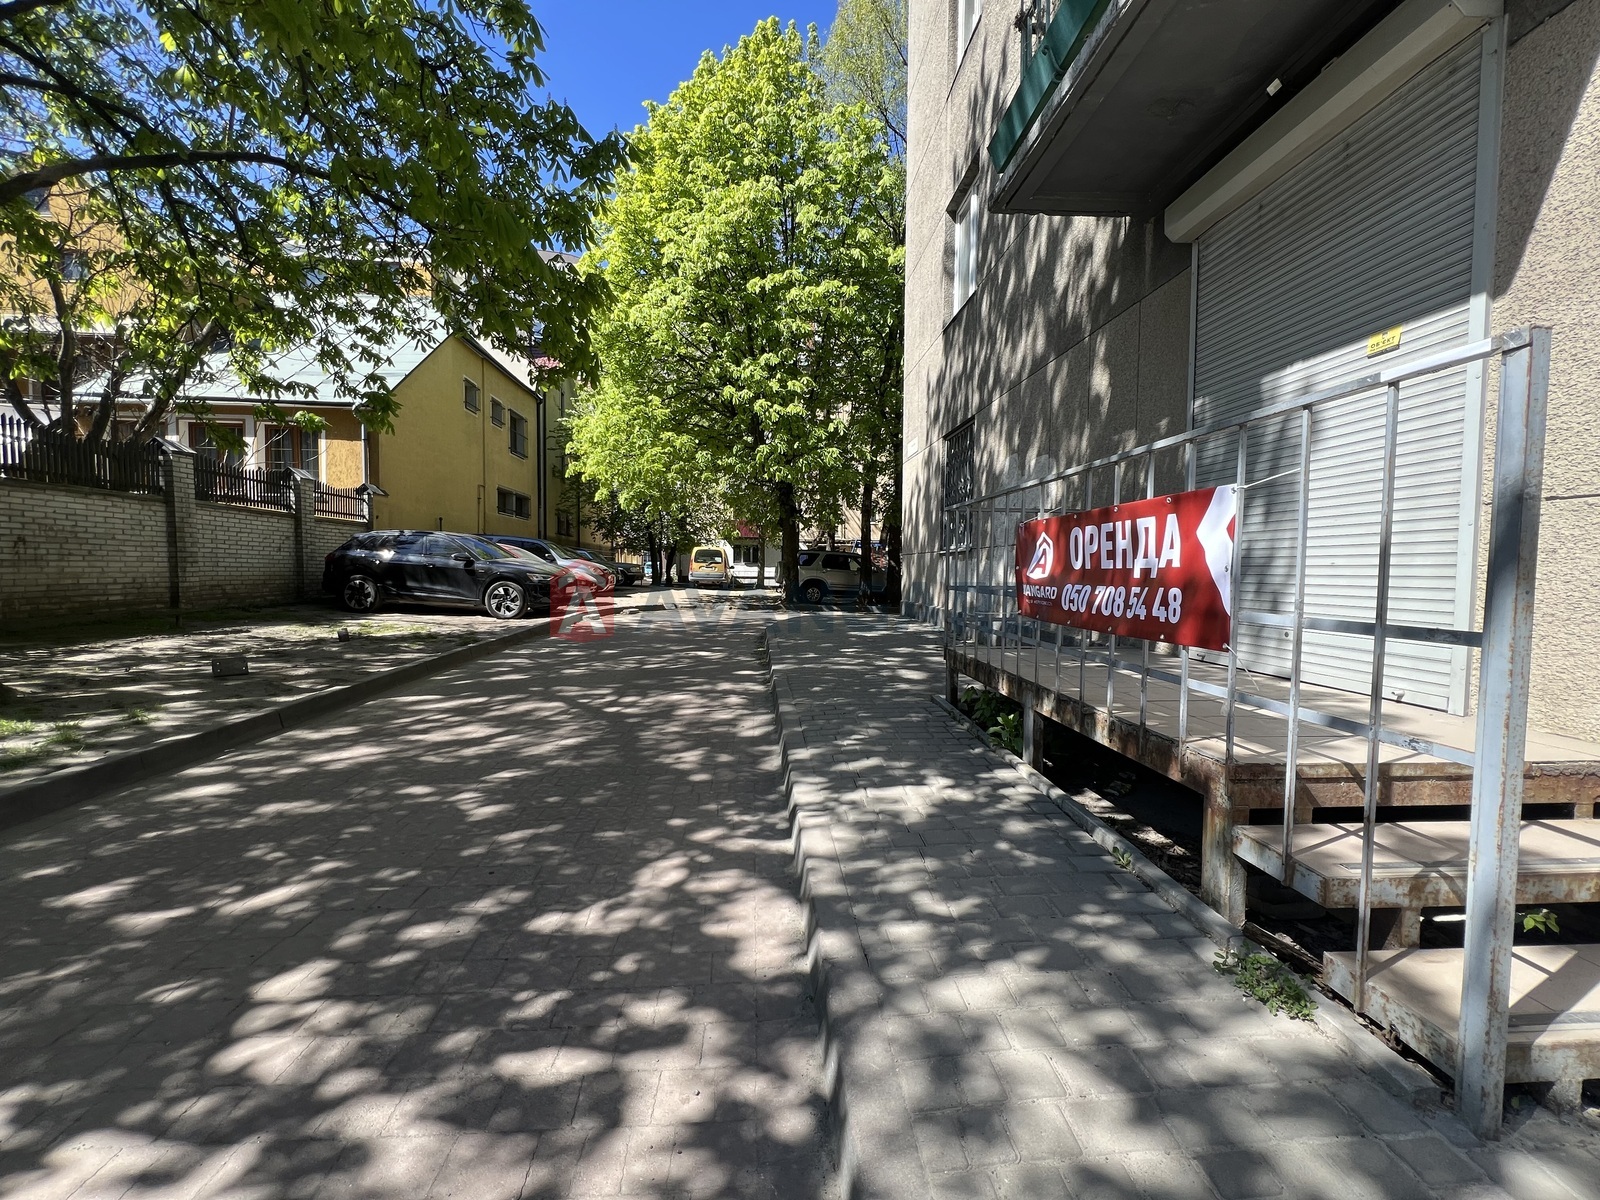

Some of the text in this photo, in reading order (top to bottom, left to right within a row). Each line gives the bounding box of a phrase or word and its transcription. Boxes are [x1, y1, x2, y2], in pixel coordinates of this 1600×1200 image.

[1069, 513, 1182, 579] ОРЕНДА
[1061, 583, 1183, 624] 050 708 54 48
